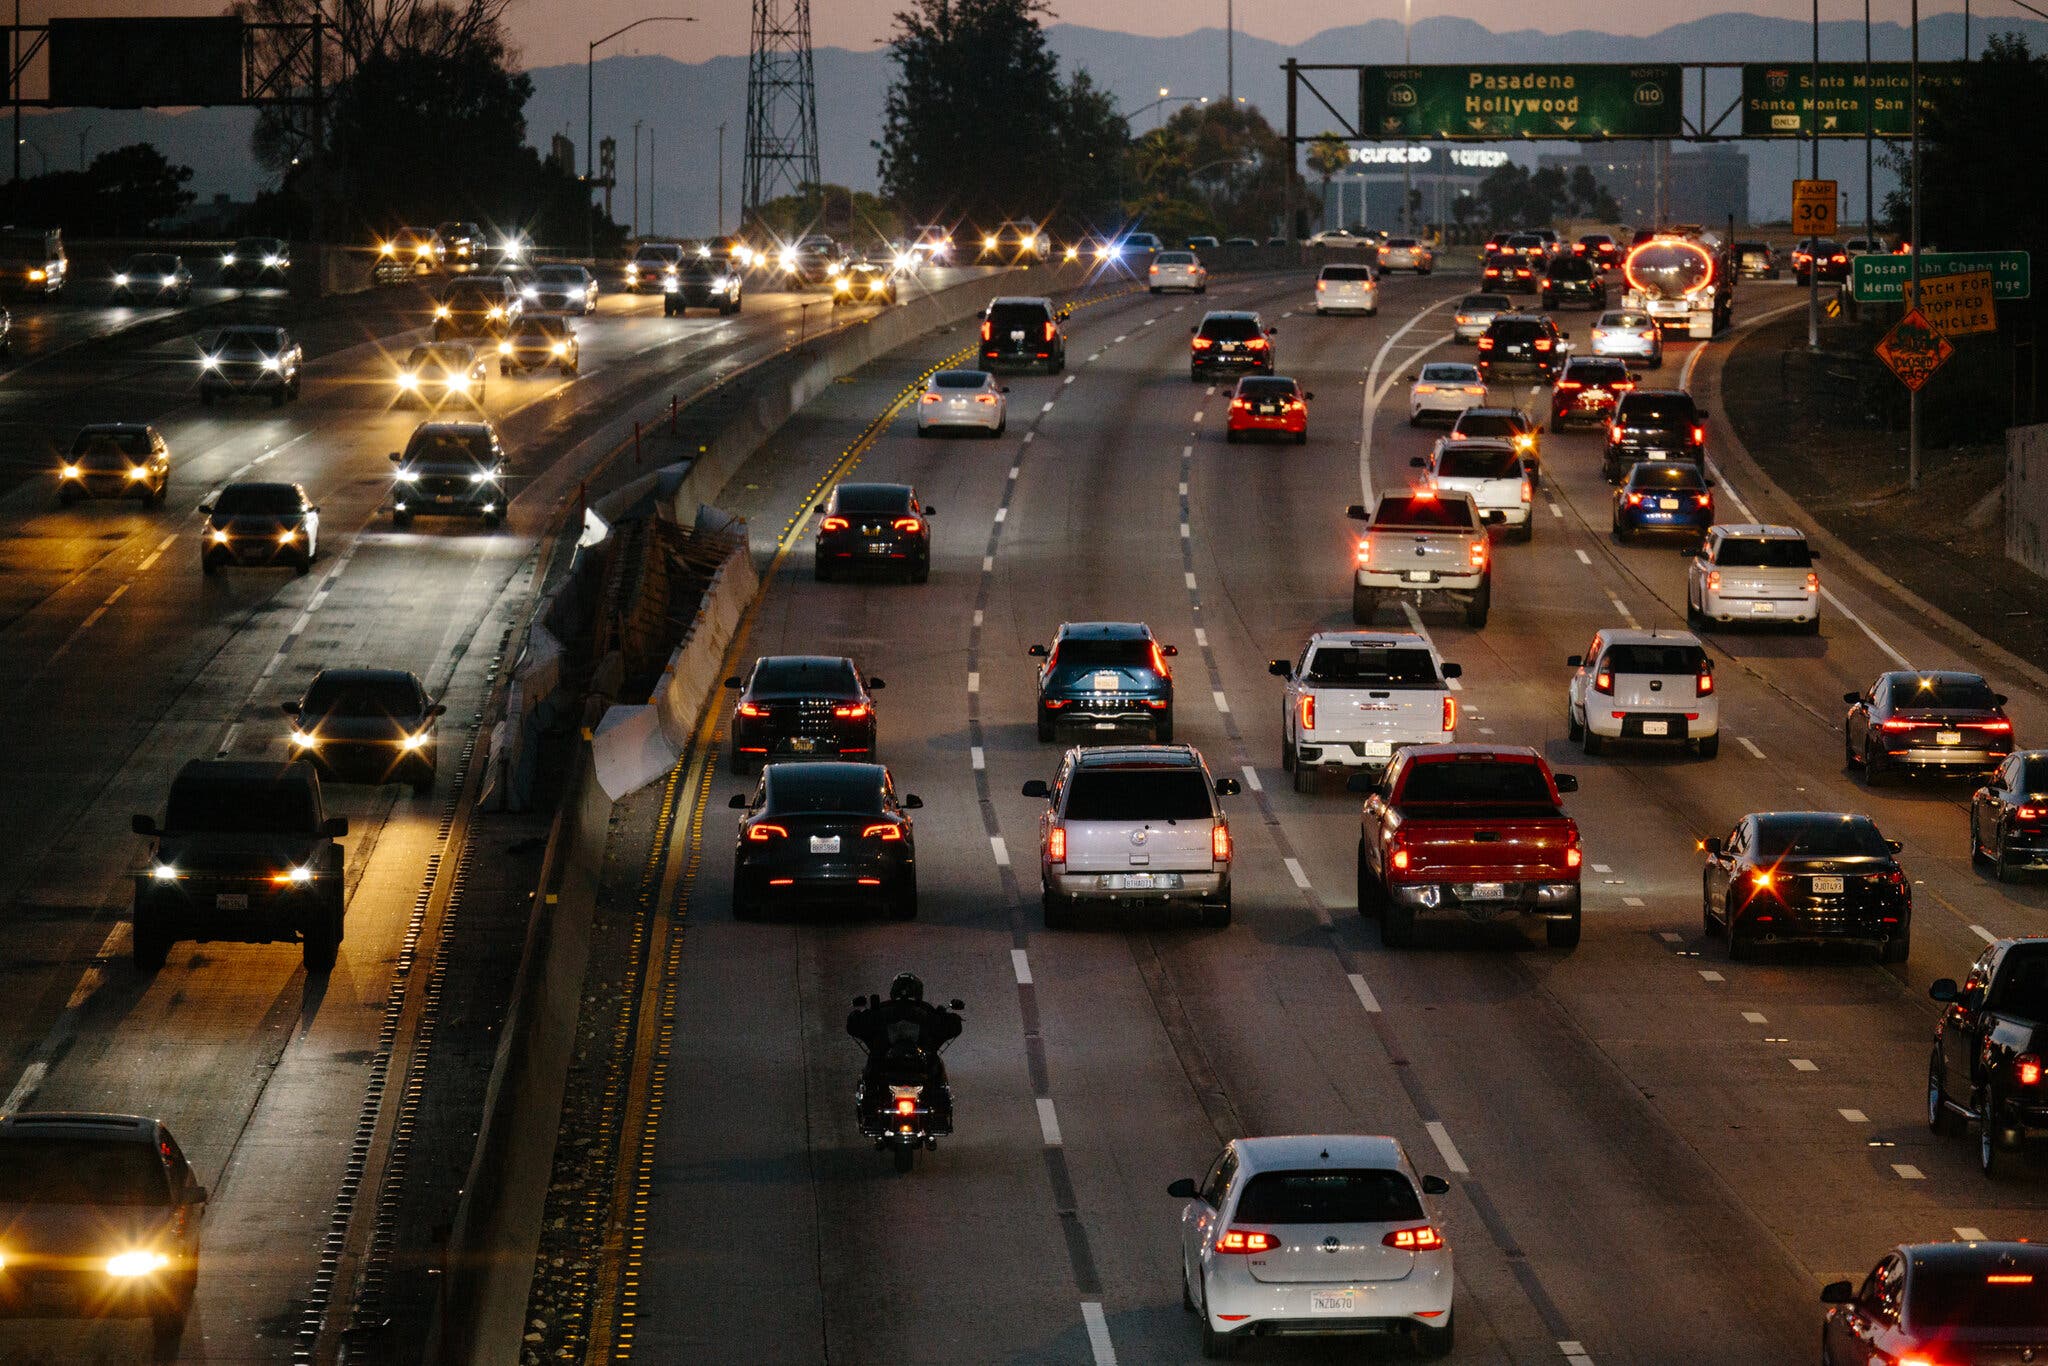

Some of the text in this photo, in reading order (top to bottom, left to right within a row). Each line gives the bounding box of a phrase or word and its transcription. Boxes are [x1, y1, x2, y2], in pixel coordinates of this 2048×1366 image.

[1384, 70, 1423, 79] NORTH
[1631, 69, 1668, 78] NORTH
[1469, 72, 1576, 90] Pasadena
[1770, 76, 1785, 87] 10
[1392, 90, 1412, 102] 110
[1639, 89, 1660, 102] 110
[1465, 95, 1579, 116] Hollywood
[1751, 98, 1858, 111] Santa Monica
[1874, 97, 1904, 111] San
[1773, 117, 1797, 126] ONLY
[1800, 185, 1832, 193] RAMP
[1799, 203, 1828, 221] 30
[1863, 263, 1907, 275] Dosan
[2000, 260, 2019, 271] Ho
[1863, 282, 1903, 293] Memo
[1961, 278, 1990, 292] FOR
[1932, 314, 1989, 329] HICLES
[1314, 1298, 1352, 1309] 7NZD670
